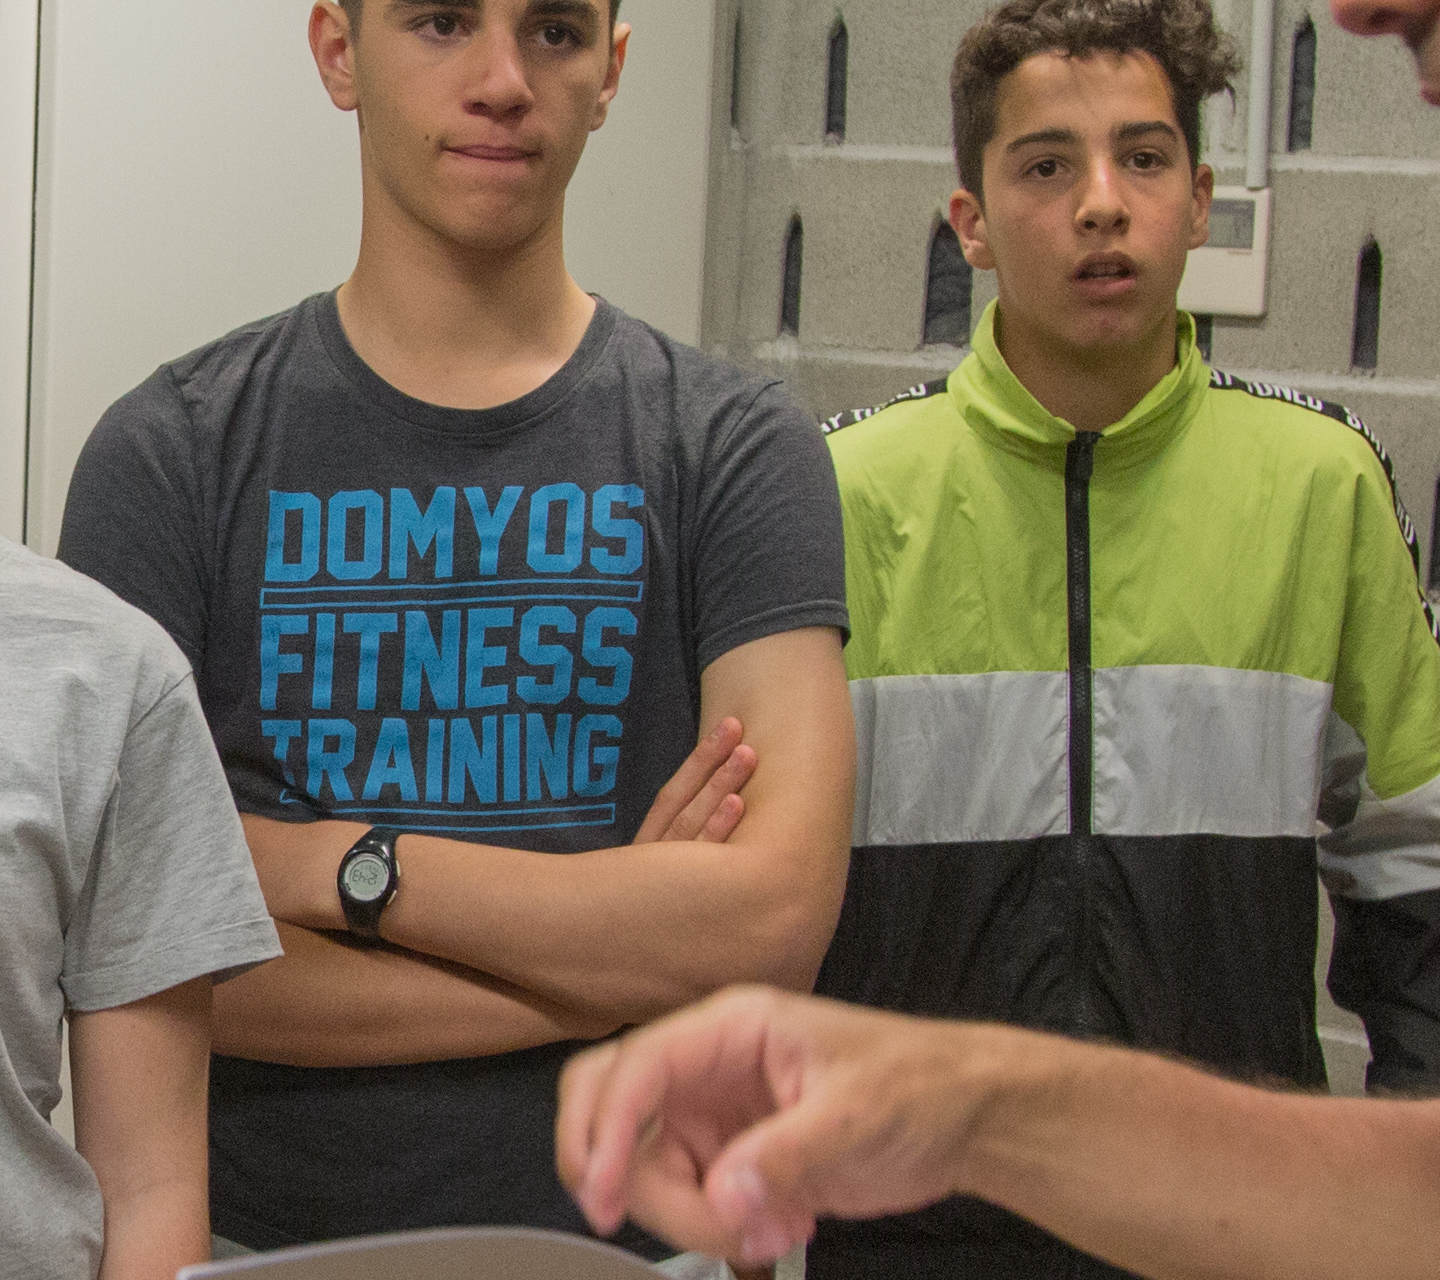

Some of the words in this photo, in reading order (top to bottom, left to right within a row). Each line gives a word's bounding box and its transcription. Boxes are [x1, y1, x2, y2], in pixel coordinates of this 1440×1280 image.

[263, 481, 646, 582] DOMYOS
[258, 604, 639, 711] FITNESS
[261, 713, 624, 804] TRAINING
